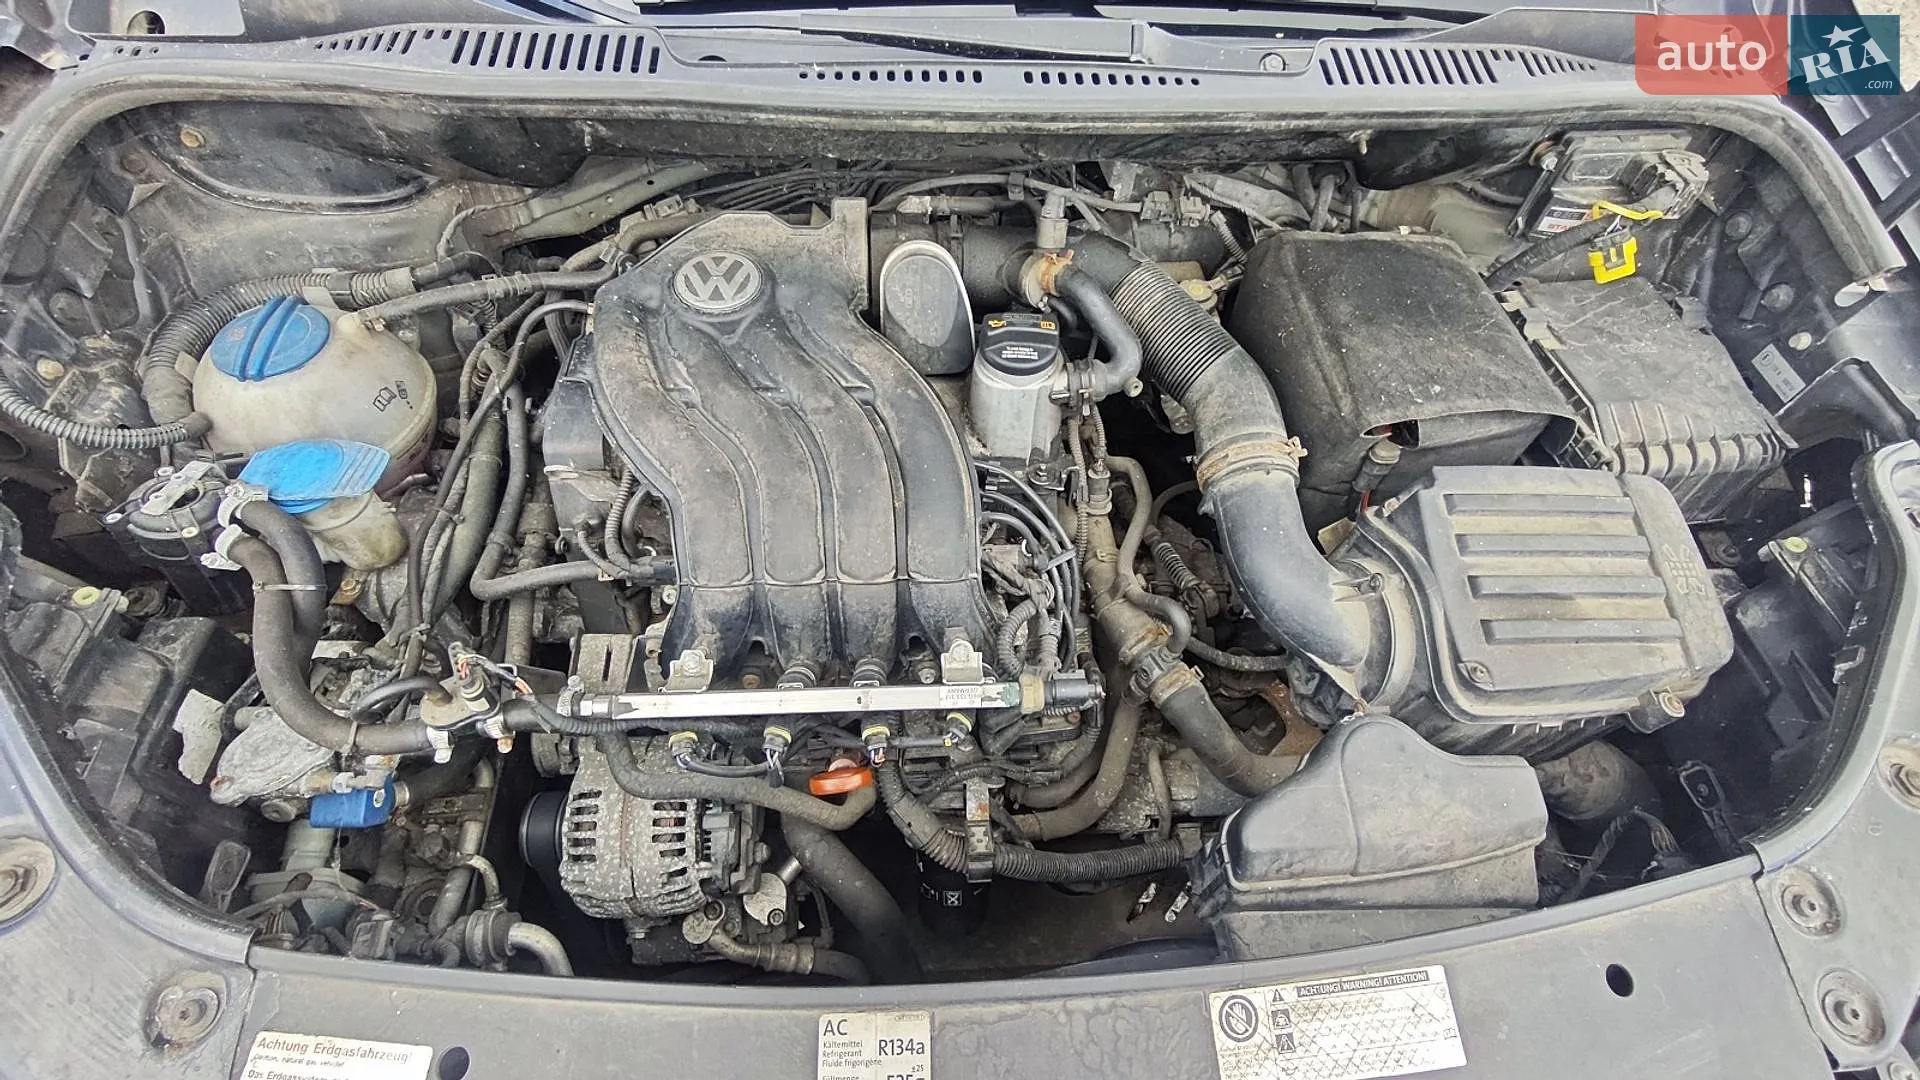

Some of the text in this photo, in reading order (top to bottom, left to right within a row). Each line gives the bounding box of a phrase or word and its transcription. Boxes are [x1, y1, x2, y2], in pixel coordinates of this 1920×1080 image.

[1299, 971, 1427, 997] ACHTUNG! WARNING! ATTENTION!
[823, 1019, 848, 1037] AC
[257, 1037, 309, 1055] Achtung
[822, 1050, 862, 1060] Refrigerant
[878, 1038, 926, 1056] R134a
[822, 1059, 843, 1068] Fluide
